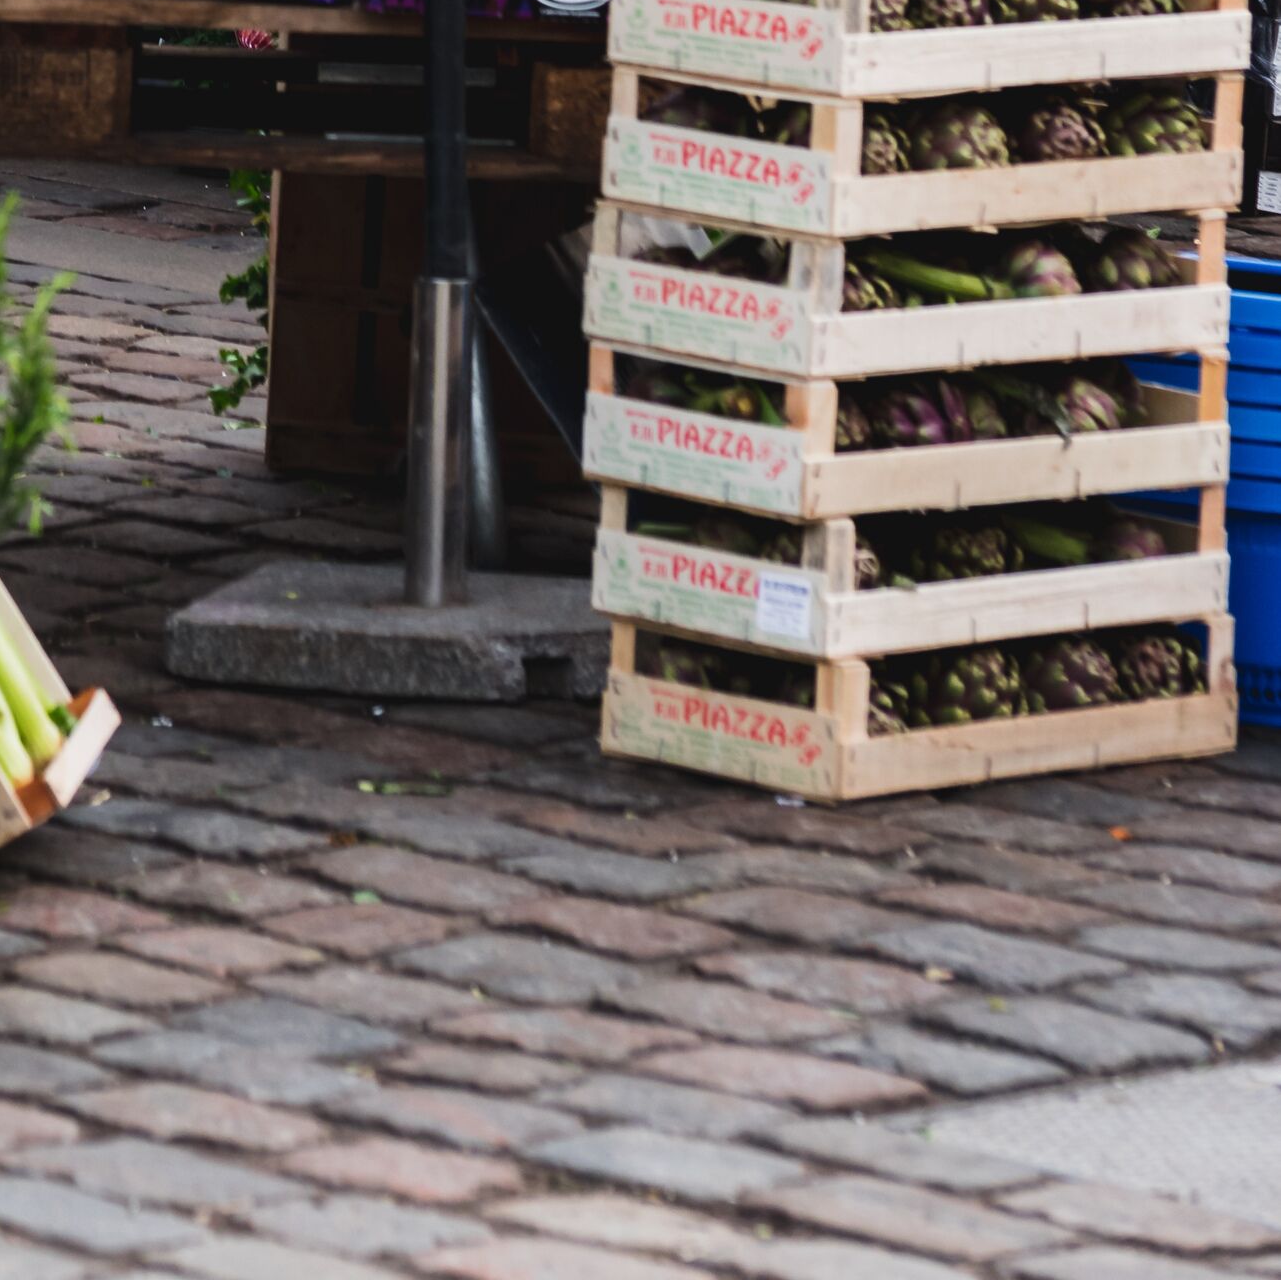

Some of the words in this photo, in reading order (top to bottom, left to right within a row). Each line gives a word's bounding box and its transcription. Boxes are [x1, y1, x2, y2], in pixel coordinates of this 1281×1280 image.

[691, 3, 790, 43] PIAZZA
[681, 139, 781, 187] PIAZZA
[661, 278, 760, 322] PIAZZA
[656, 416, 755, 462] PIAZZA
[671, 554, 760, 600] PIAZZ
[683, 697, 787, 748] PIAZZA
